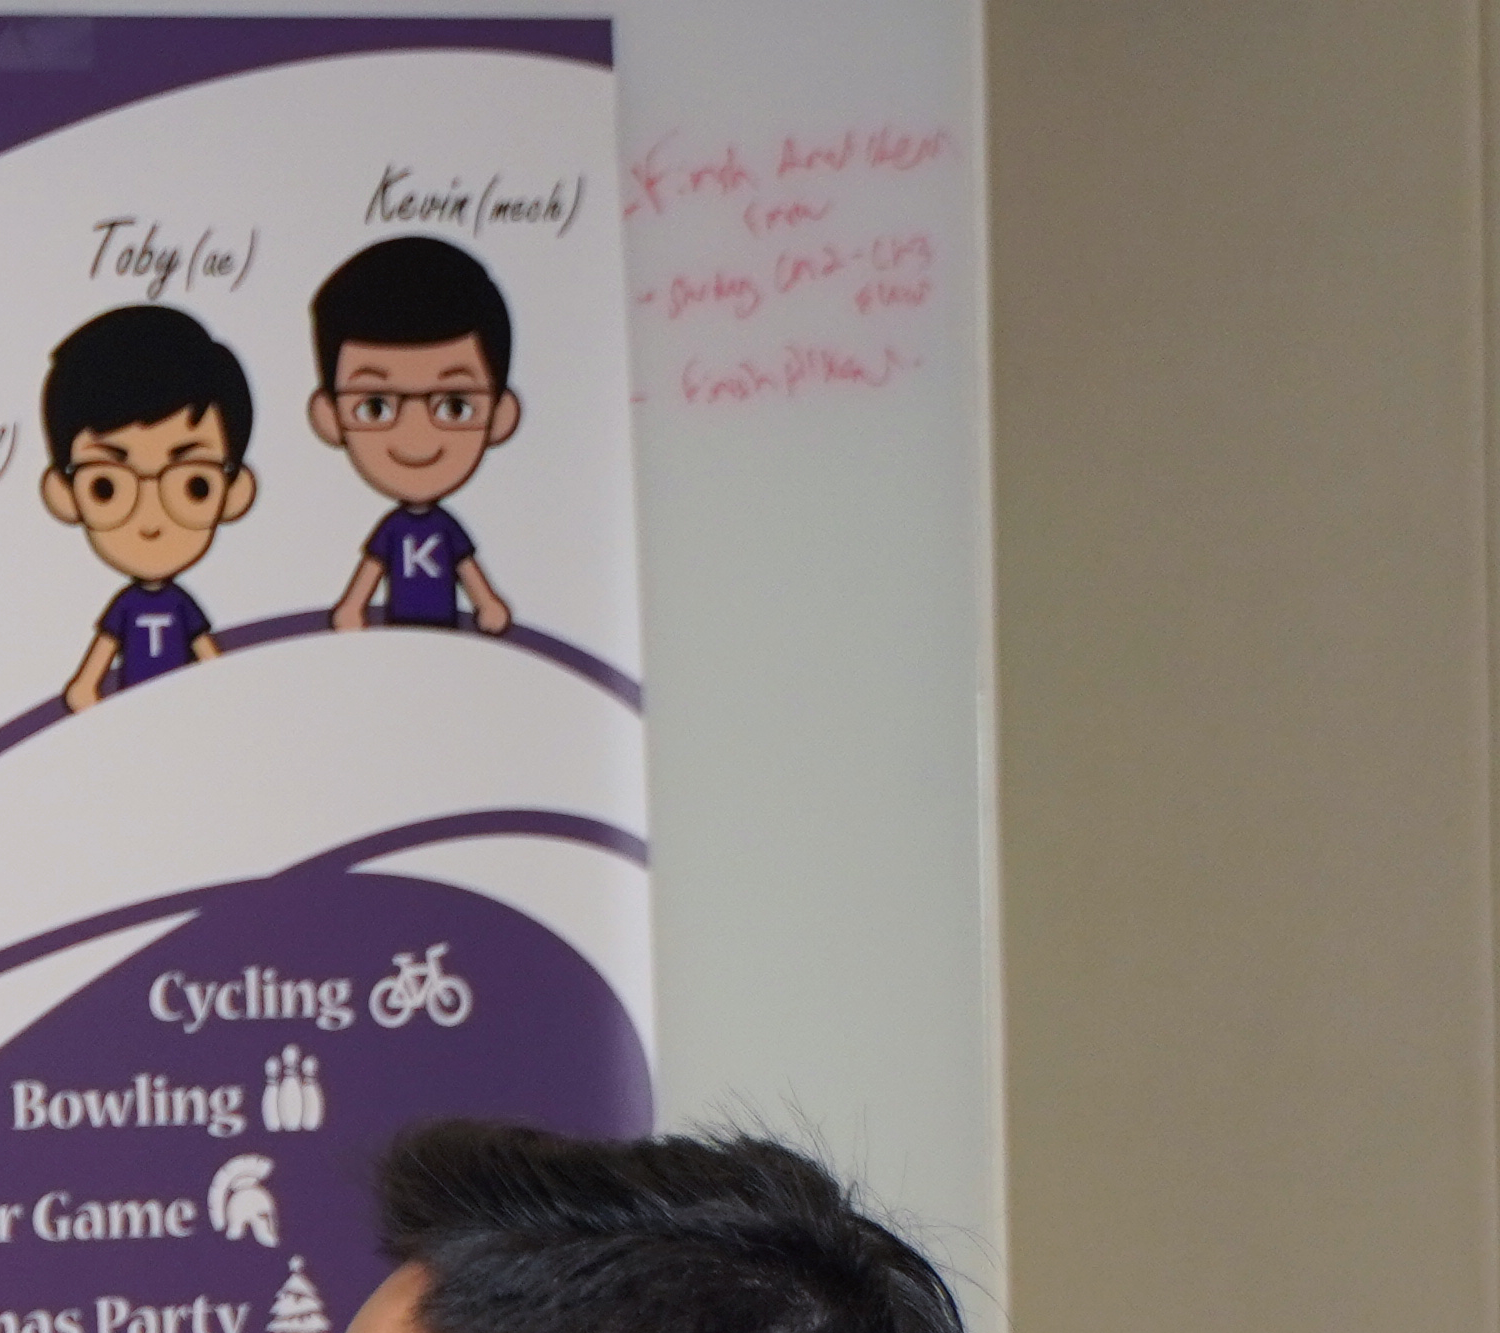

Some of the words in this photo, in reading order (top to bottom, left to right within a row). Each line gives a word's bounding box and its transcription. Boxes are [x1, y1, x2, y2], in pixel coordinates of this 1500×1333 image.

[364, 163, 470, 227] Kevin
[90, 214, 180, 301] Toby
[403, 537, 441, 579] K
[136, 614, 174, 657] T
[148, 964, 356, 1034] Cycling
[11, 1073, 247, 1137] Bowling
[32, 1191, 197, 1244] Game
